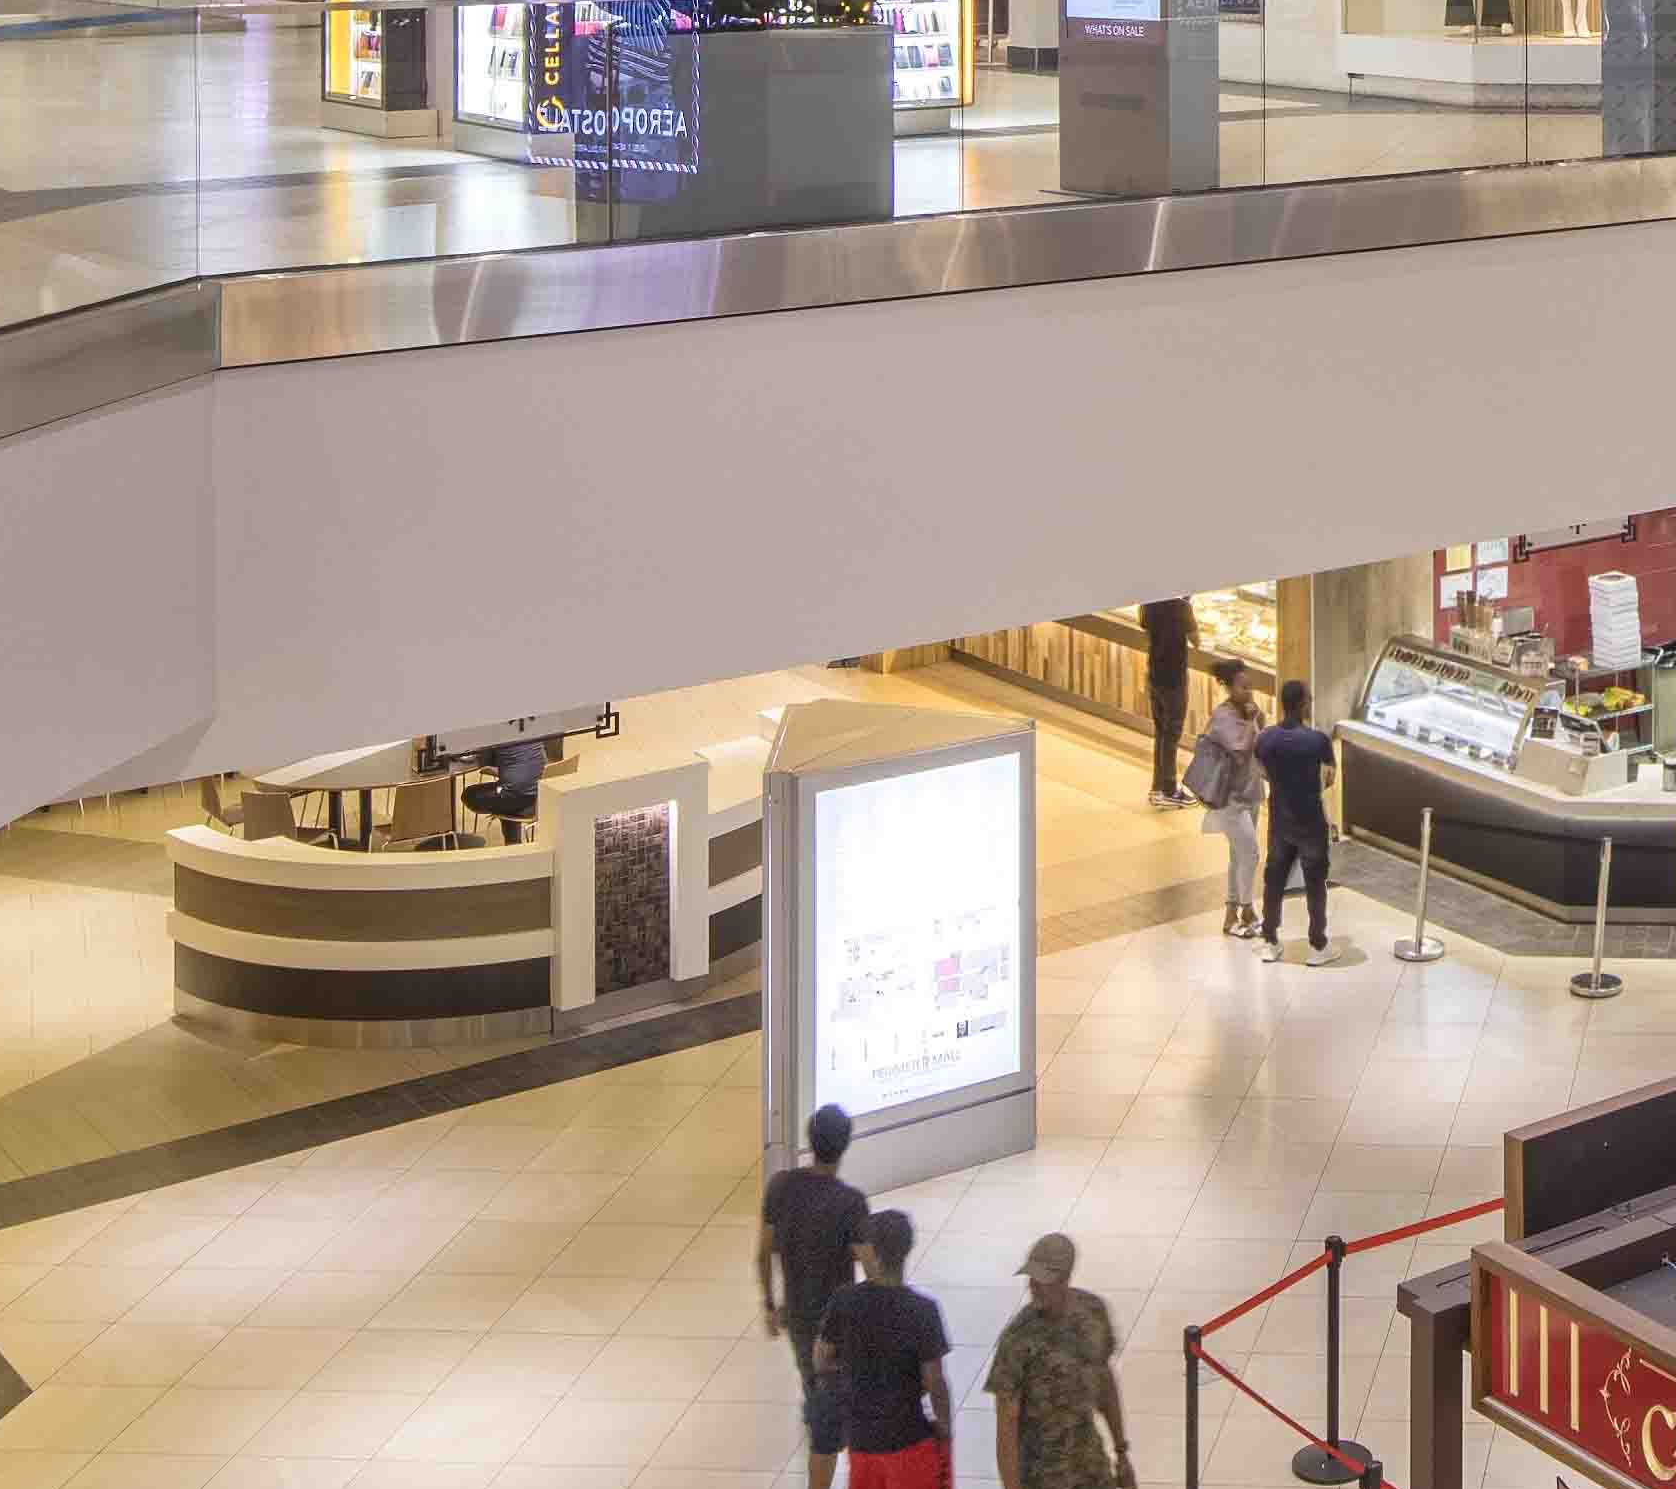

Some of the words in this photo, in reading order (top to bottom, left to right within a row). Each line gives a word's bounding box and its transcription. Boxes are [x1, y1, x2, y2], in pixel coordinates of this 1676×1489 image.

[1084, 24, 1112, 37] WHAT'S
[1112, 25, 1125, 37] ON
[1125, 26, 1145, 38] SALE
